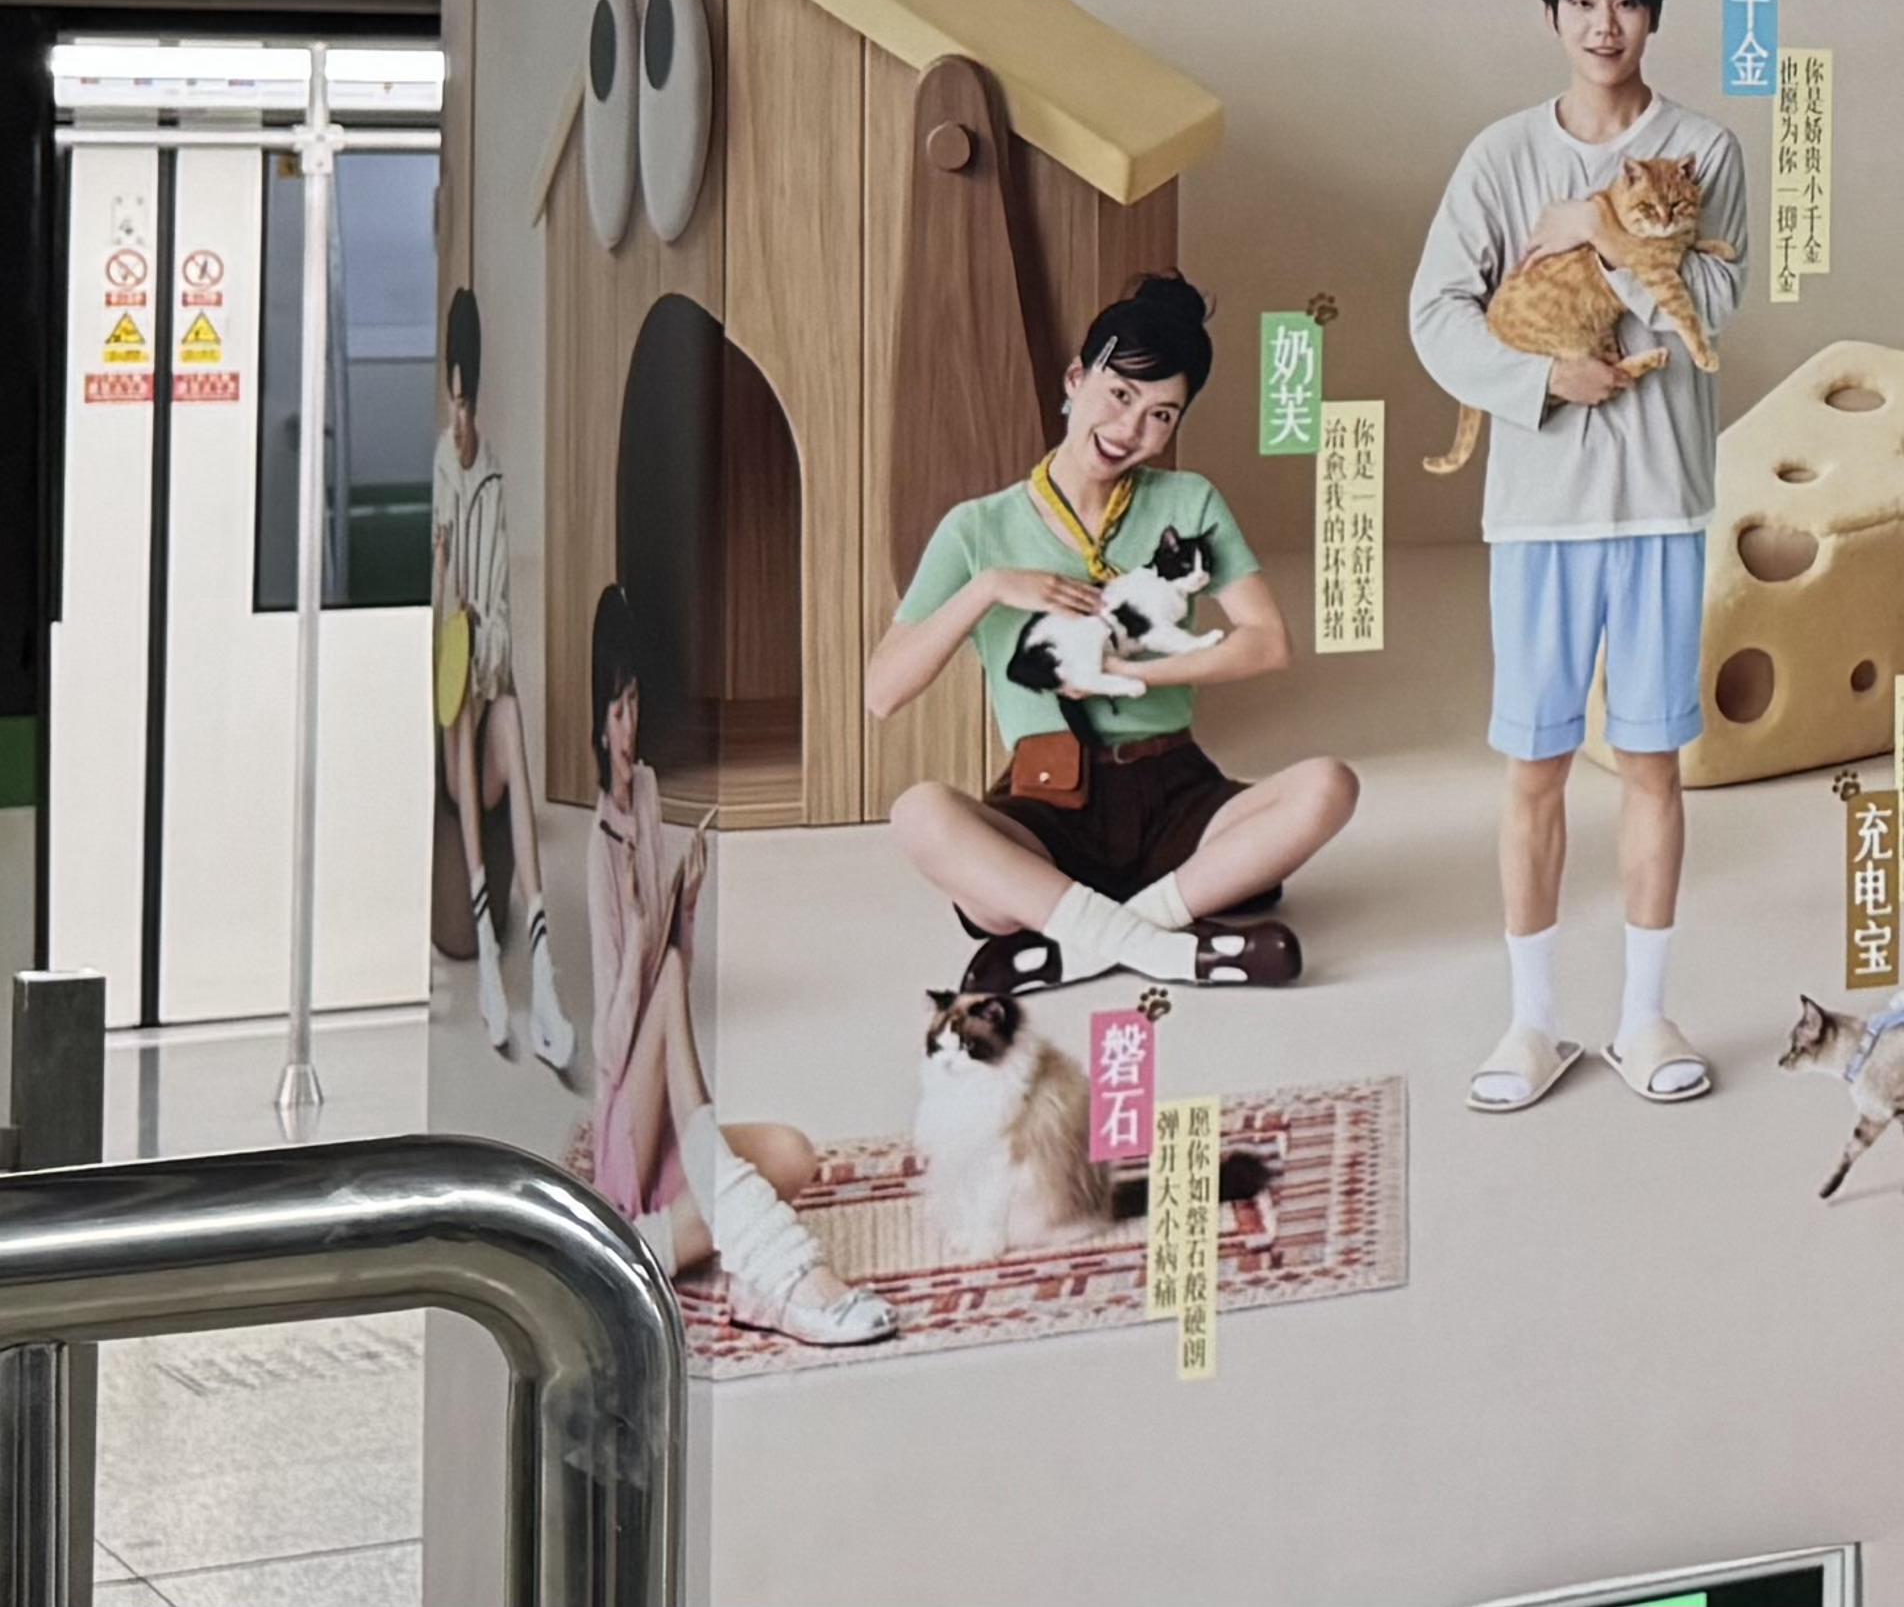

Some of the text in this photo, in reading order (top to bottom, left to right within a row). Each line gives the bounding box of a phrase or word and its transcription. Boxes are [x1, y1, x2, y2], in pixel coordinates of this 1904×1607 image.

[1269, 325, 1315, 446] 奶芙
[1351, 416, 1376, 641] 你是一块舒芙蕾
[1853, 802, 1894, 976] 充电宝
[1099, 1022, 1148, 1149] 磐石
